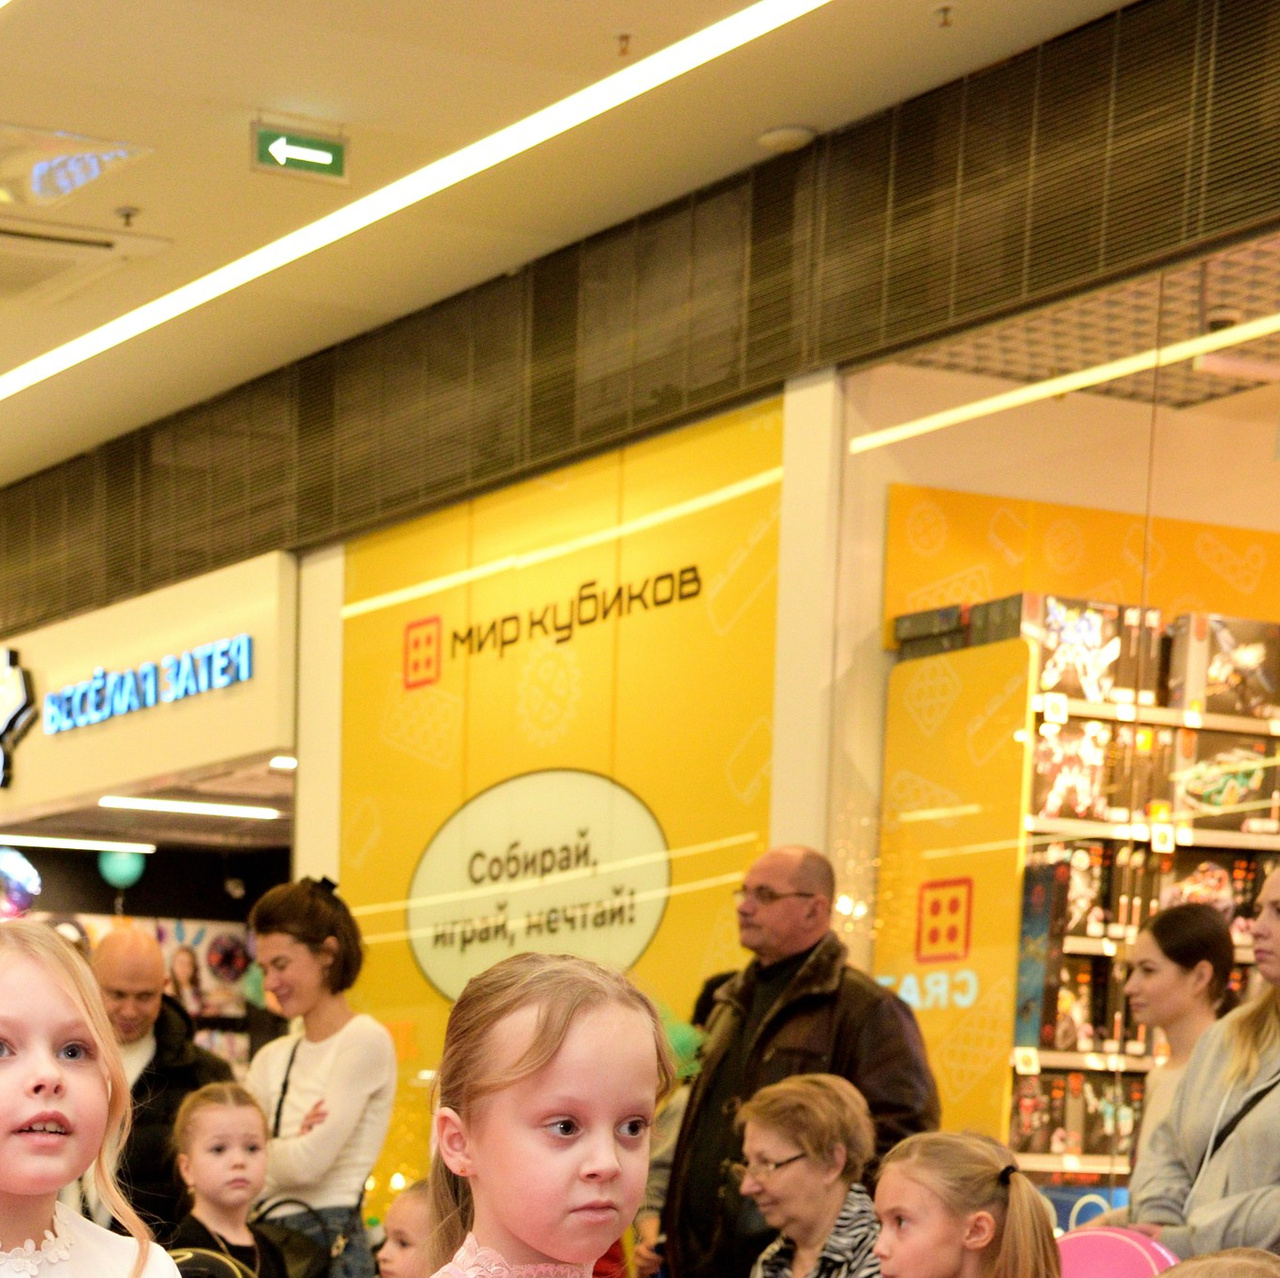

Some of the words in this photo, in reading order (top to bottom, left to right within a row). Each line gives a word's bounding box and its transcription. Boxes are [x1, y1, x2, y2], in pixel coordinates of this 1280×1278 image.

[42, 666, 157, 735] ВЕСЁЛАЯ
[160, 633, 252, 703] ЗАТЕЯ
[468, 827, 599, 884] Собирай,
